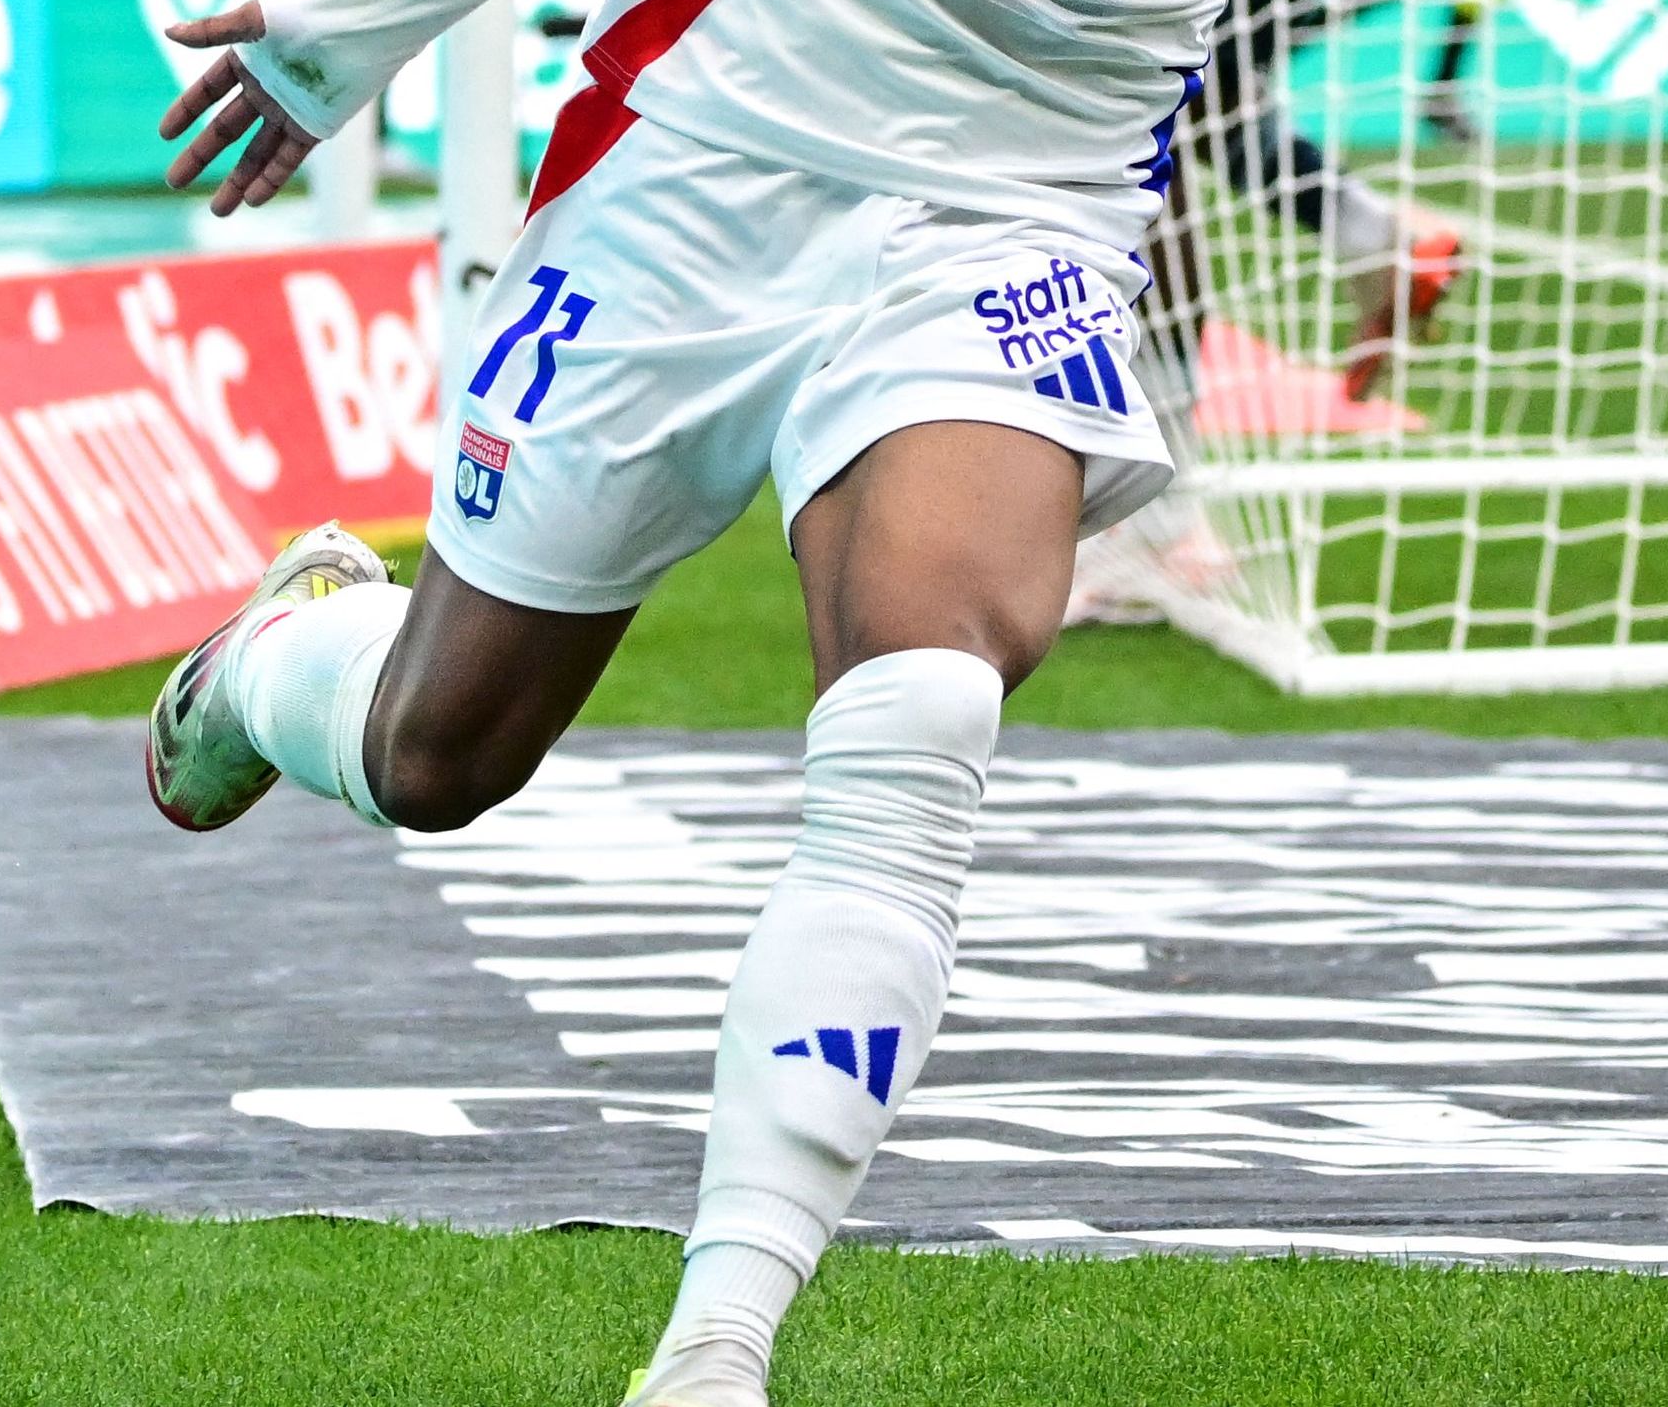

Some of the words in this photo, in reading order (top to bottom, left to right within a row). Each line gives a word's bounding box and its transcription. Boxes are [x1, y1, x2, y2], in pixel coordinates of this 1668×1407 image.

[973, 258, 1087, 334] Staff
[467, 265, 598, 424] 11
[457, 459, 493, 511] OL
